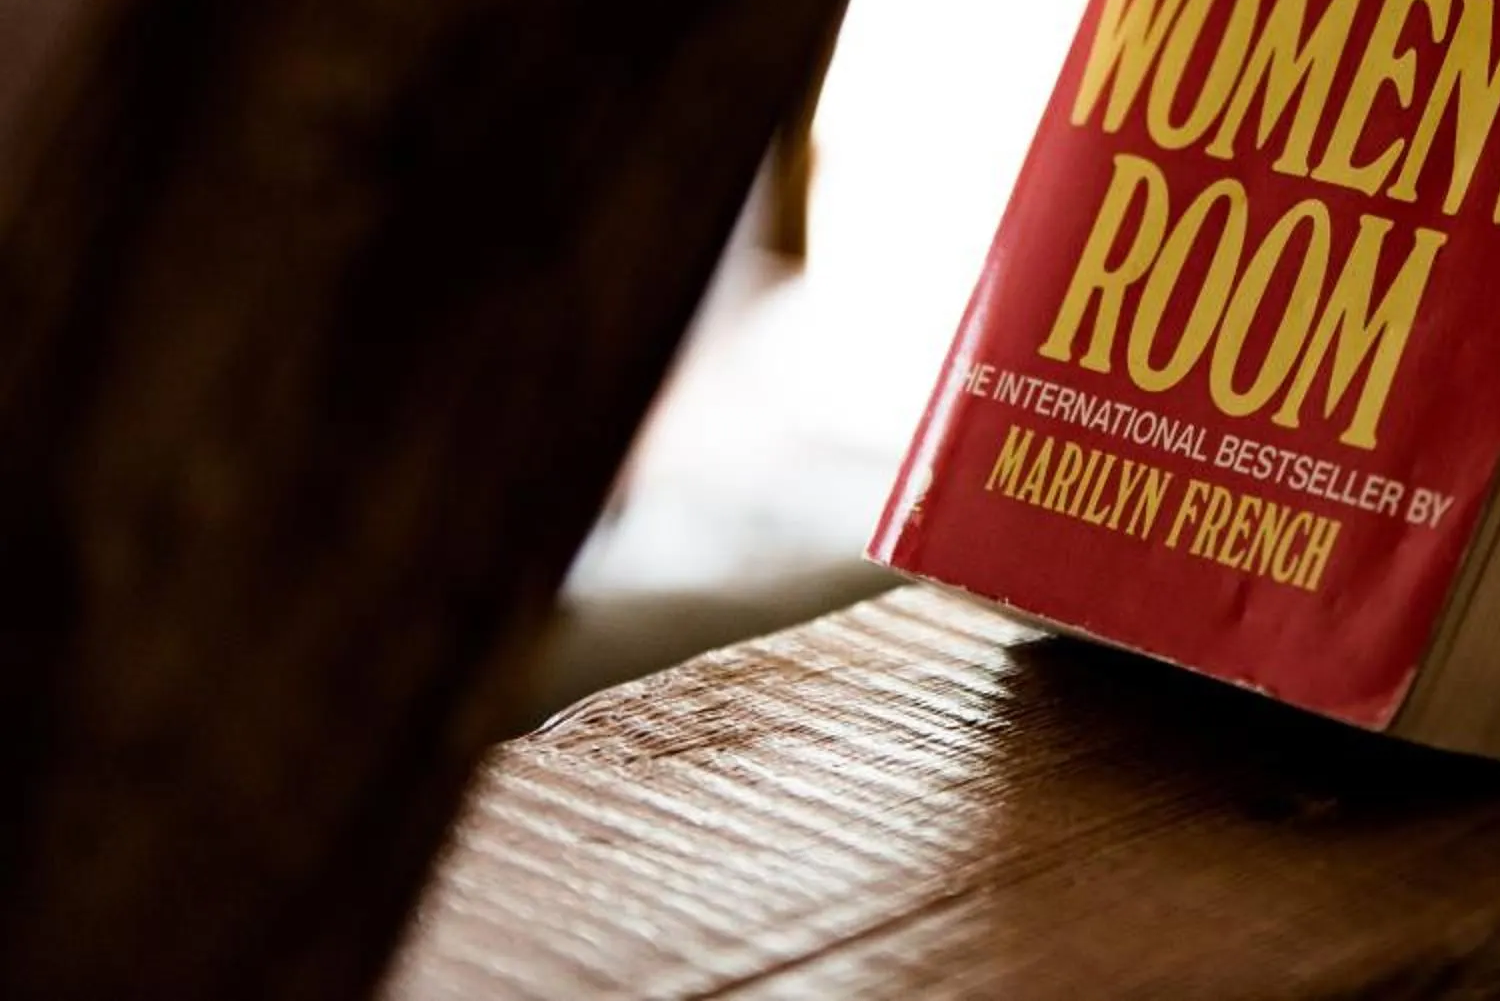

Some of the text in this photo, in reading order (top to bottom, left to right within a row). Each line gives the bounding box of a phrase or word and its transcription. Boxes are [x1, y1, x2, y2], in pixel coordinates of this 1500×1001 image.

[1038, 152, 1448, 451] ROOM
[953, 362, 1455, 530] HE INTERNATIONAL BESTSELLER BY
[984, 424, 1342, 593] MARILYN FRENCH
